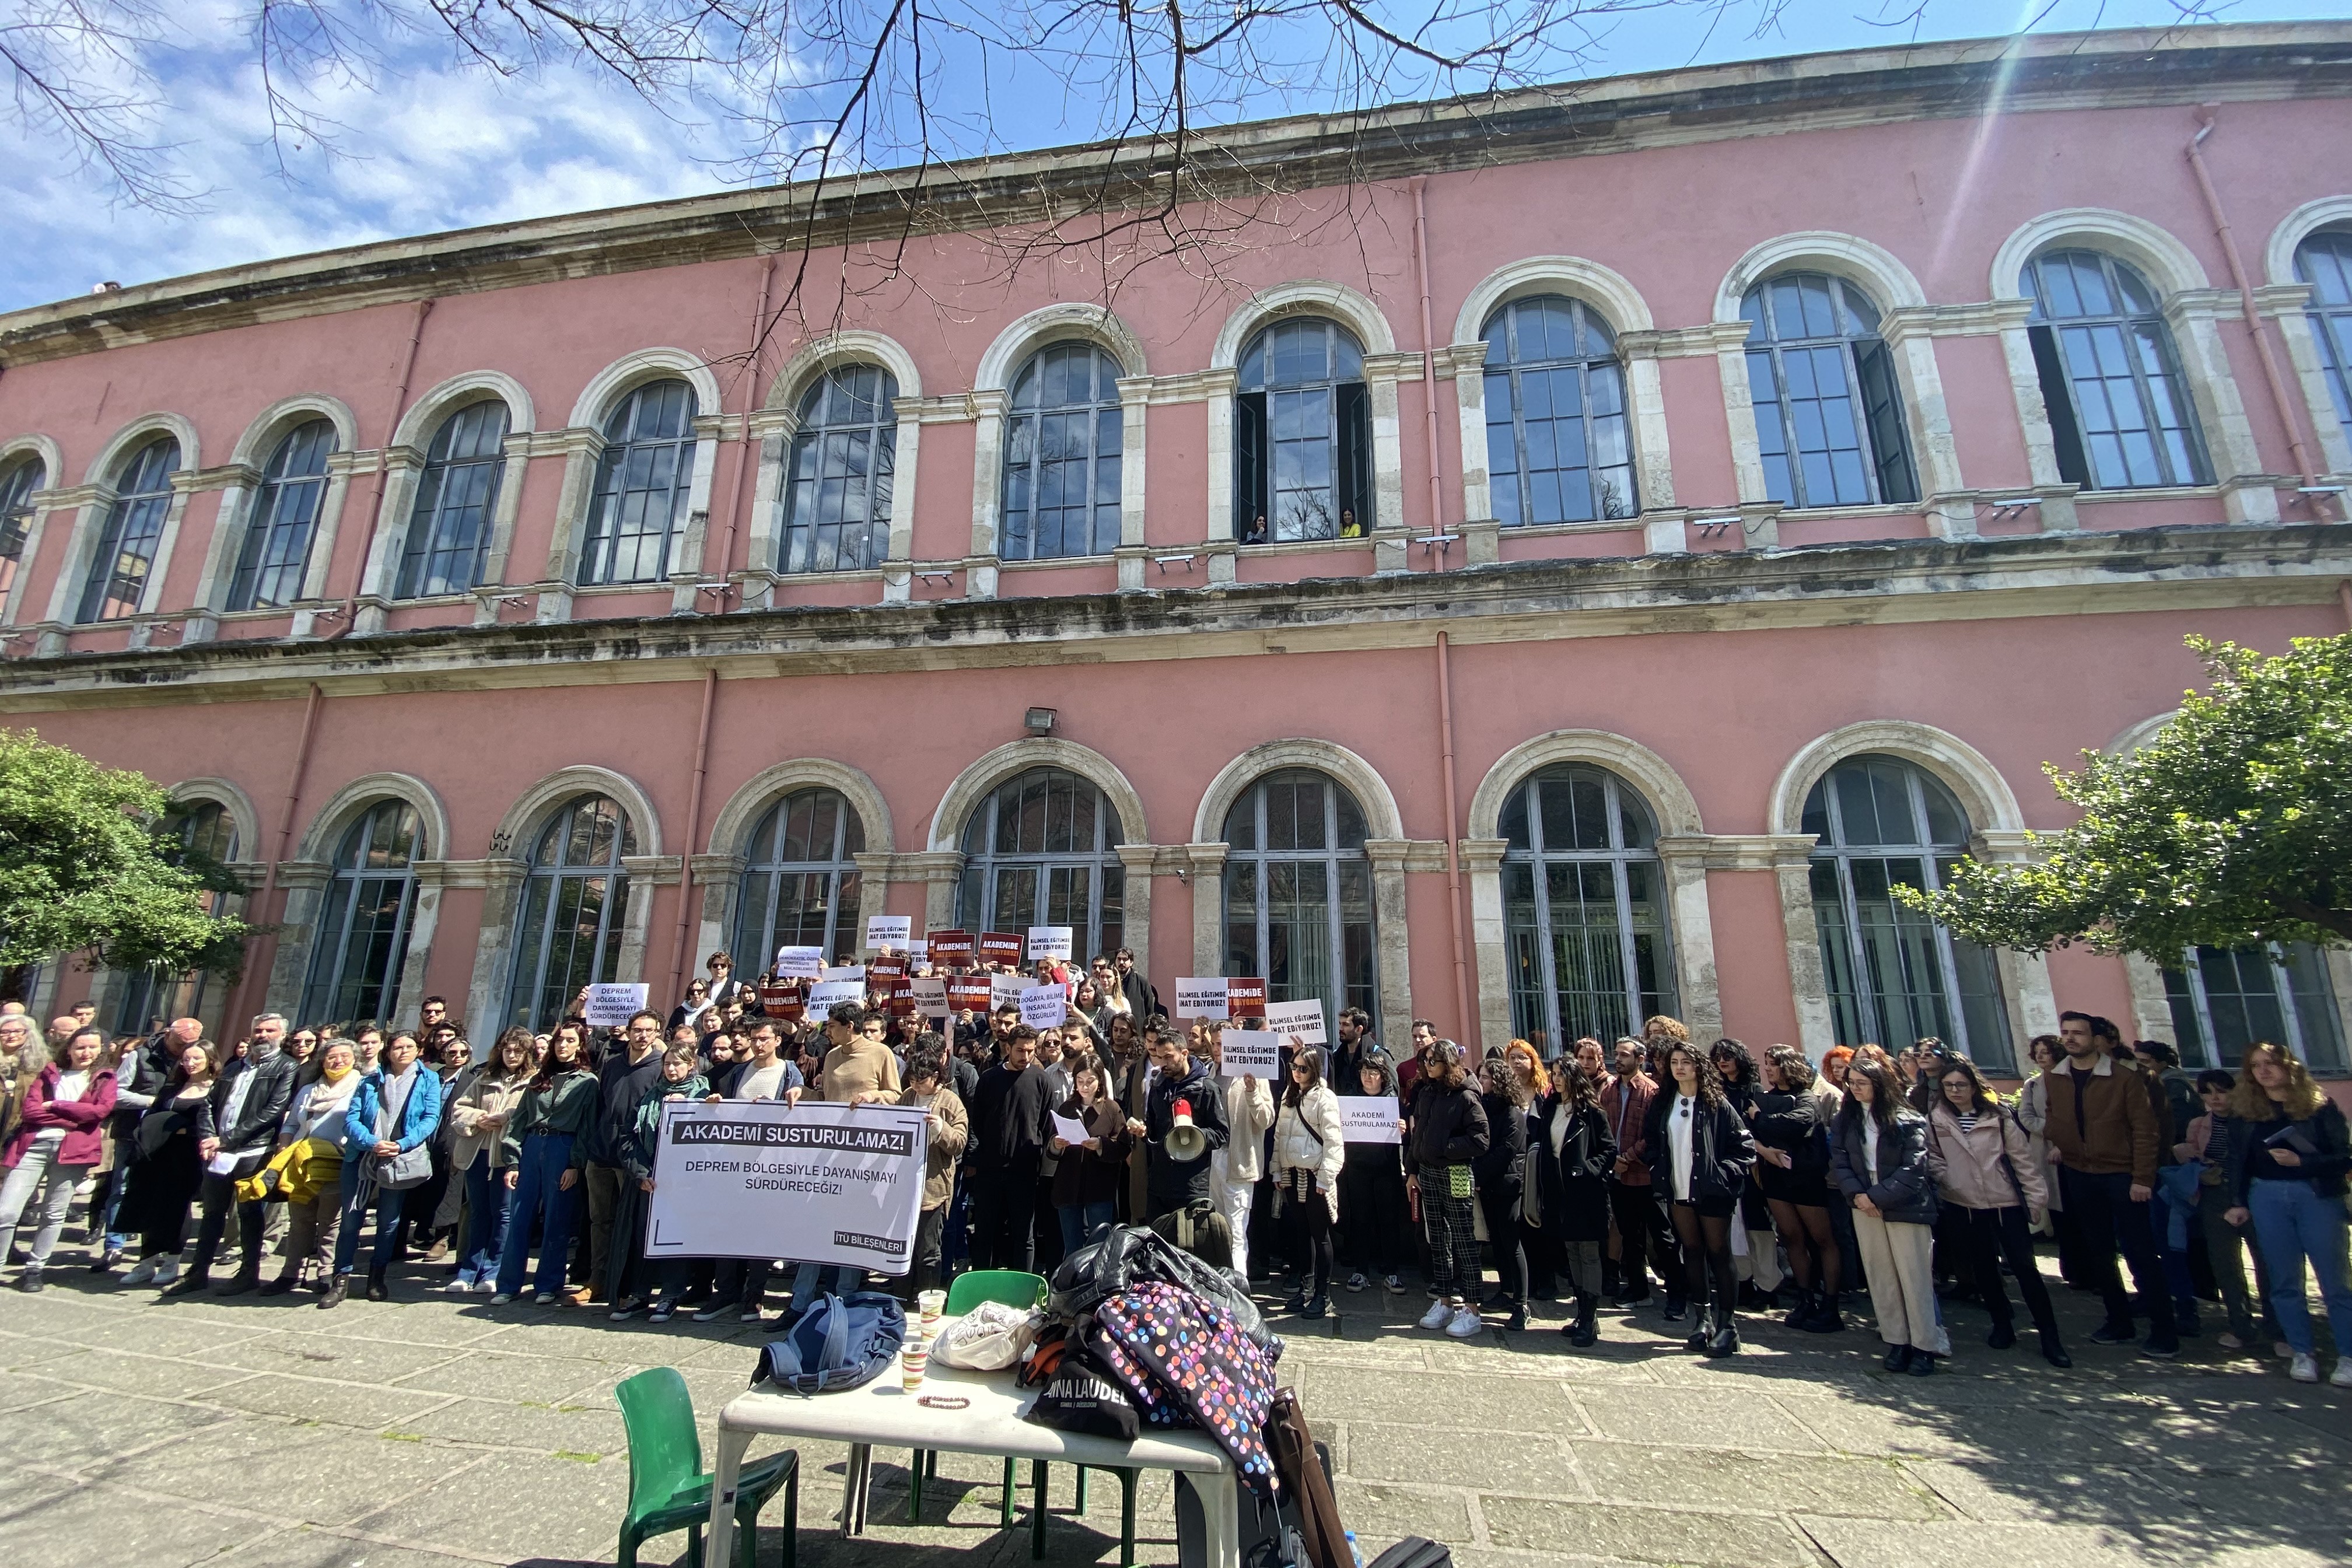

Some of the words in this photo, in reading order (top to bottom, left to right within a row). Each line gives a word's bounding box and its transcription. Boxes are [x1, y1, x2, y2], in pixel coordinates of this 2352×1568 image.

[1021, 995, 1045, 1003] DOĞAYA,
[1046, 992, 1065, 1000] BİLİME,
[1027, 1002, 1055, 1012] İNSANLIĞA
[1027, 1011, 1057, 1020] ÖZGÜRLÜK!
[681, 1124, 761, 1142] AKADEMİ
[766, 1128, 905, 1150] SUSTURULAMAZ!
[685, 1161, 740, 1172] DEPREM
[743, 1160, 820, 1176] BÖLGESİYLE
[823, 1167, 898, 1184] DAYANIŞMAYI
[745, 1177, 842, 1195] SÜRDÜRECEĞİZ!
[835, 1231, 849, 1243] İTÜ
[851, 1234, 902, 1252] BİLEŞENLERİ
[1075, 1378, 1128, 1406] LAUDEL
